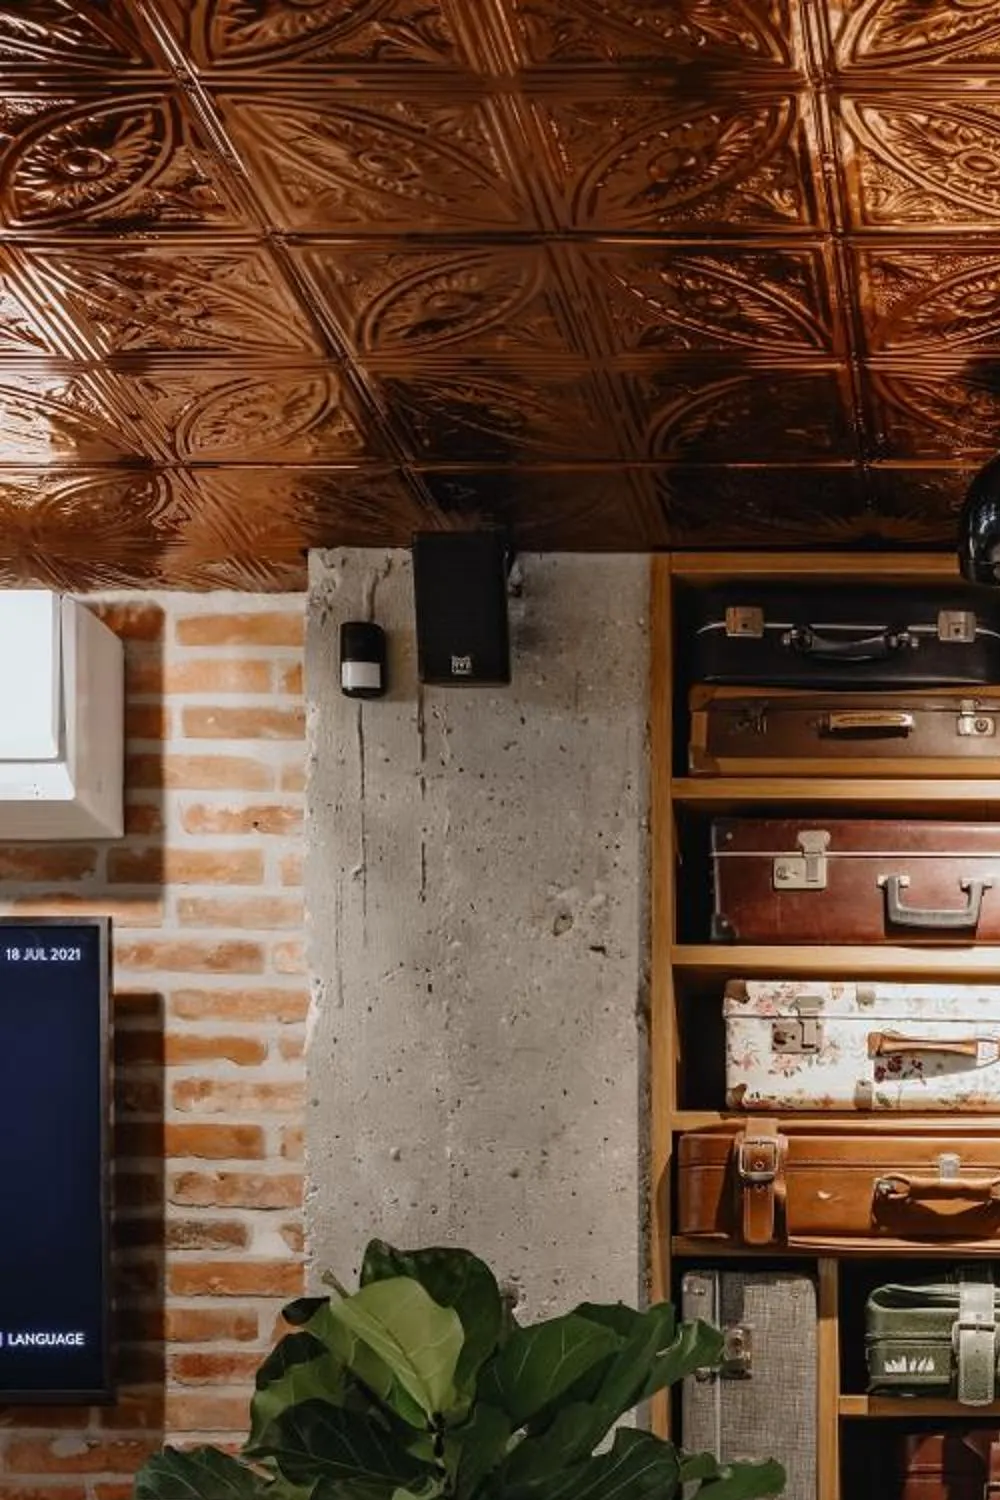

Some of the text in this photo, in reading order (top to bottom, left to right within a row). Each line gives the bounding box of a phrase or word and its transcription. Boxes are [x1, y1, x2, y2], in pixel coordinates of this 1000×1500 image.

[6, 947, 81, 960] 18 JUL 2021
[8, 1333, 85, 1346] LANGUAGE
